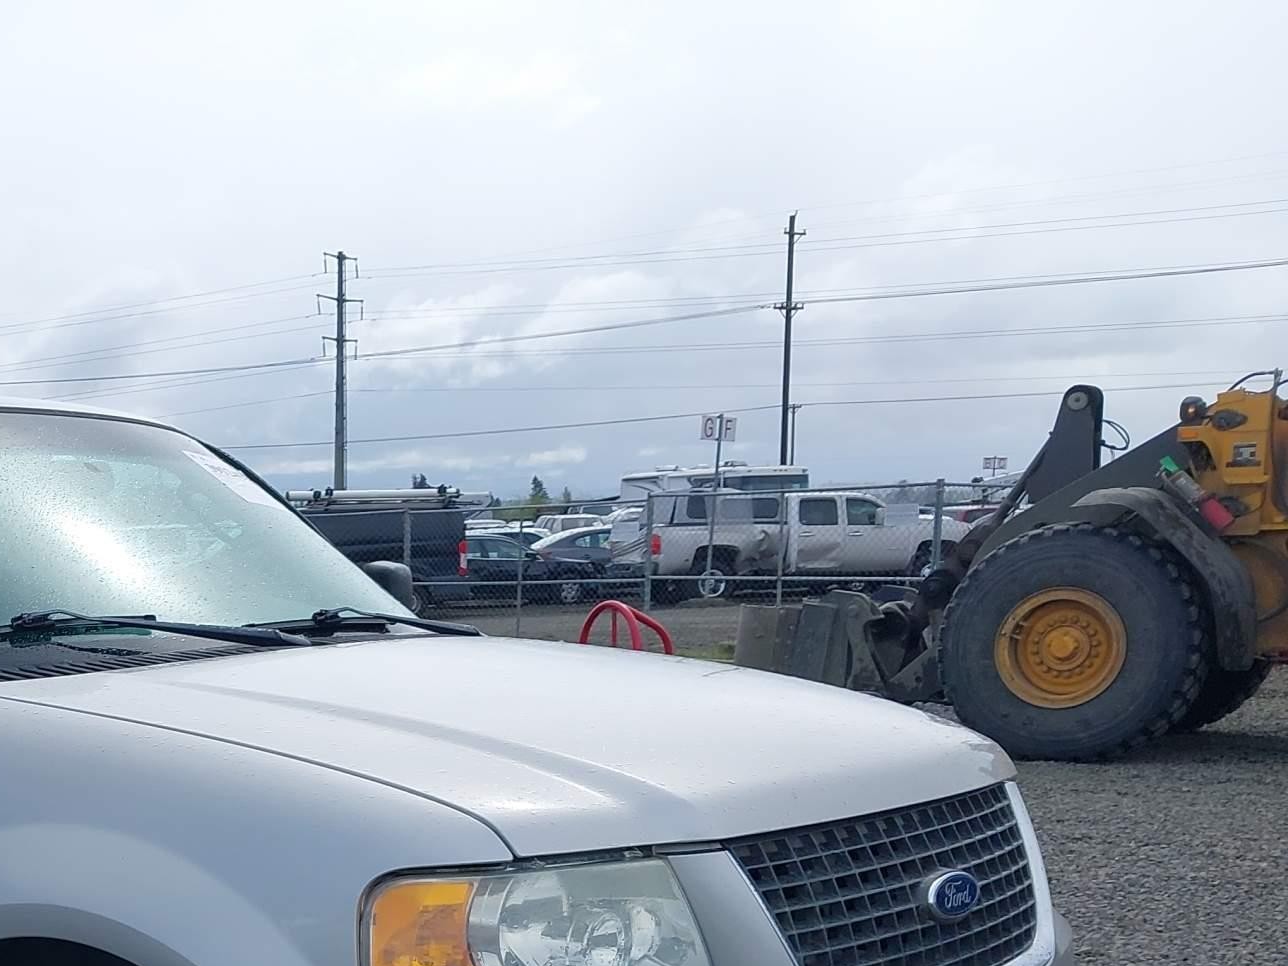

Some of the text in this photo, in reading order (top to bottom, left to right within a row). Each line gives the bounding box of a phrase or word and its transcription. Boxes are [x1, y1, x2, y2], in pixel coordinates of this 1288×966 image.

[704, 417, 733, 439] G F
[944, 880, 972, 909] Ford
